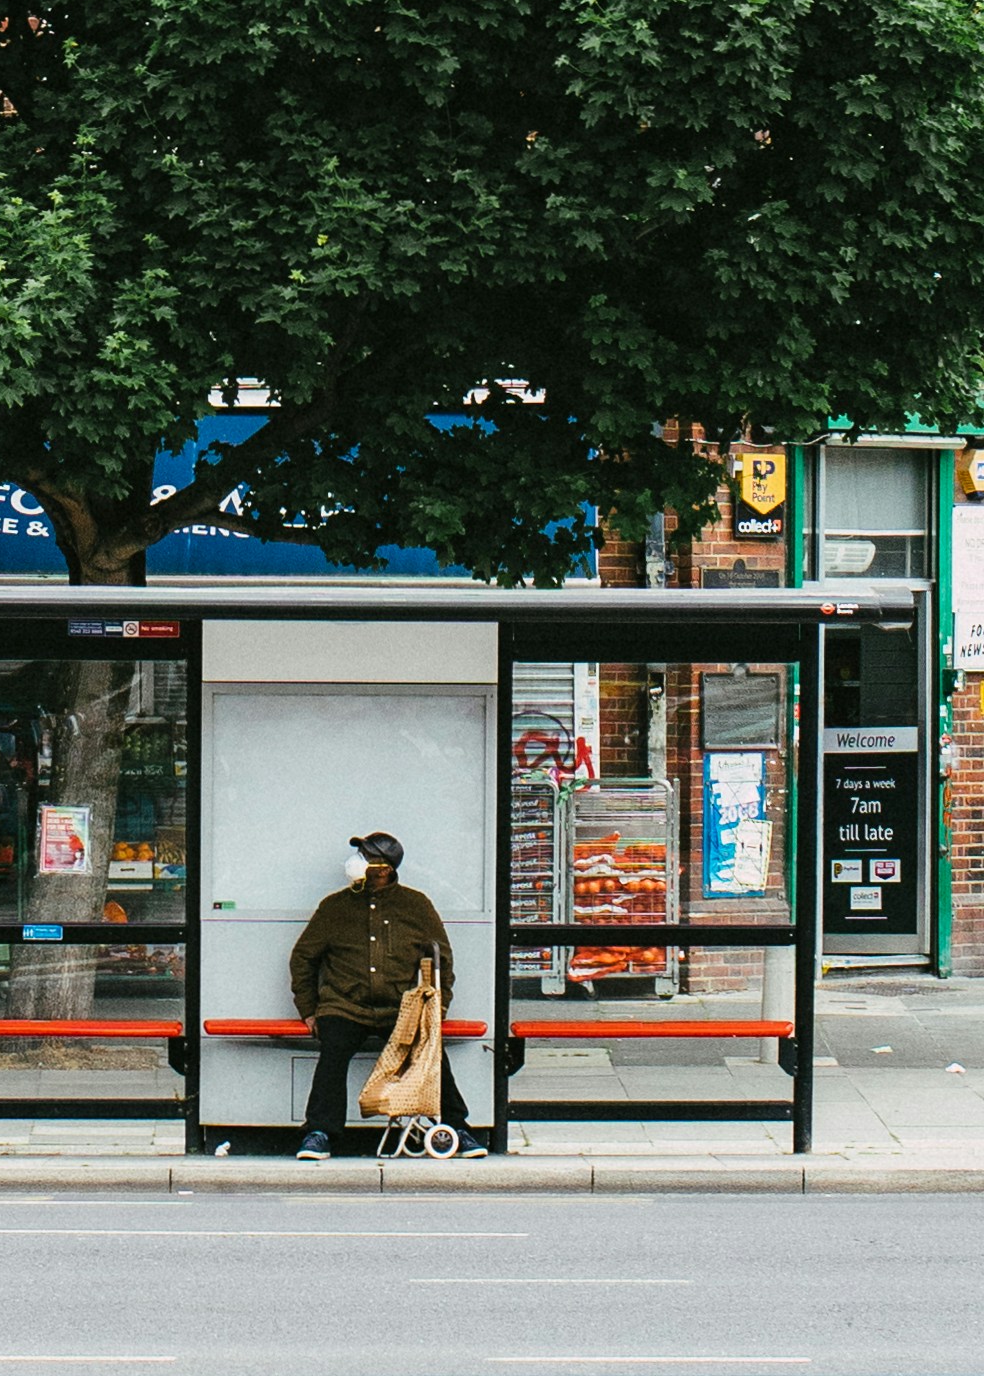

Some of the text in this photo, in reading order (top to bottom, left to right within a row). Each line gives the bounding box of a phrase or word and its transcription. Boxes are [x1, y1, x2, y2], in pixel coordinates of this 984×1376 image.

[752, 492, 776, 503] Point
[25, 520, 50, 537] &
[151, 625, 174, 633] smoking
[970, 624, 984, 638] FO
[836, 732, 896, 748] Welcome
[835, 778, 896, 791] 7 days a week
[850, 796, 882, 814] 7am
[839, 823, 894, 841] till late
